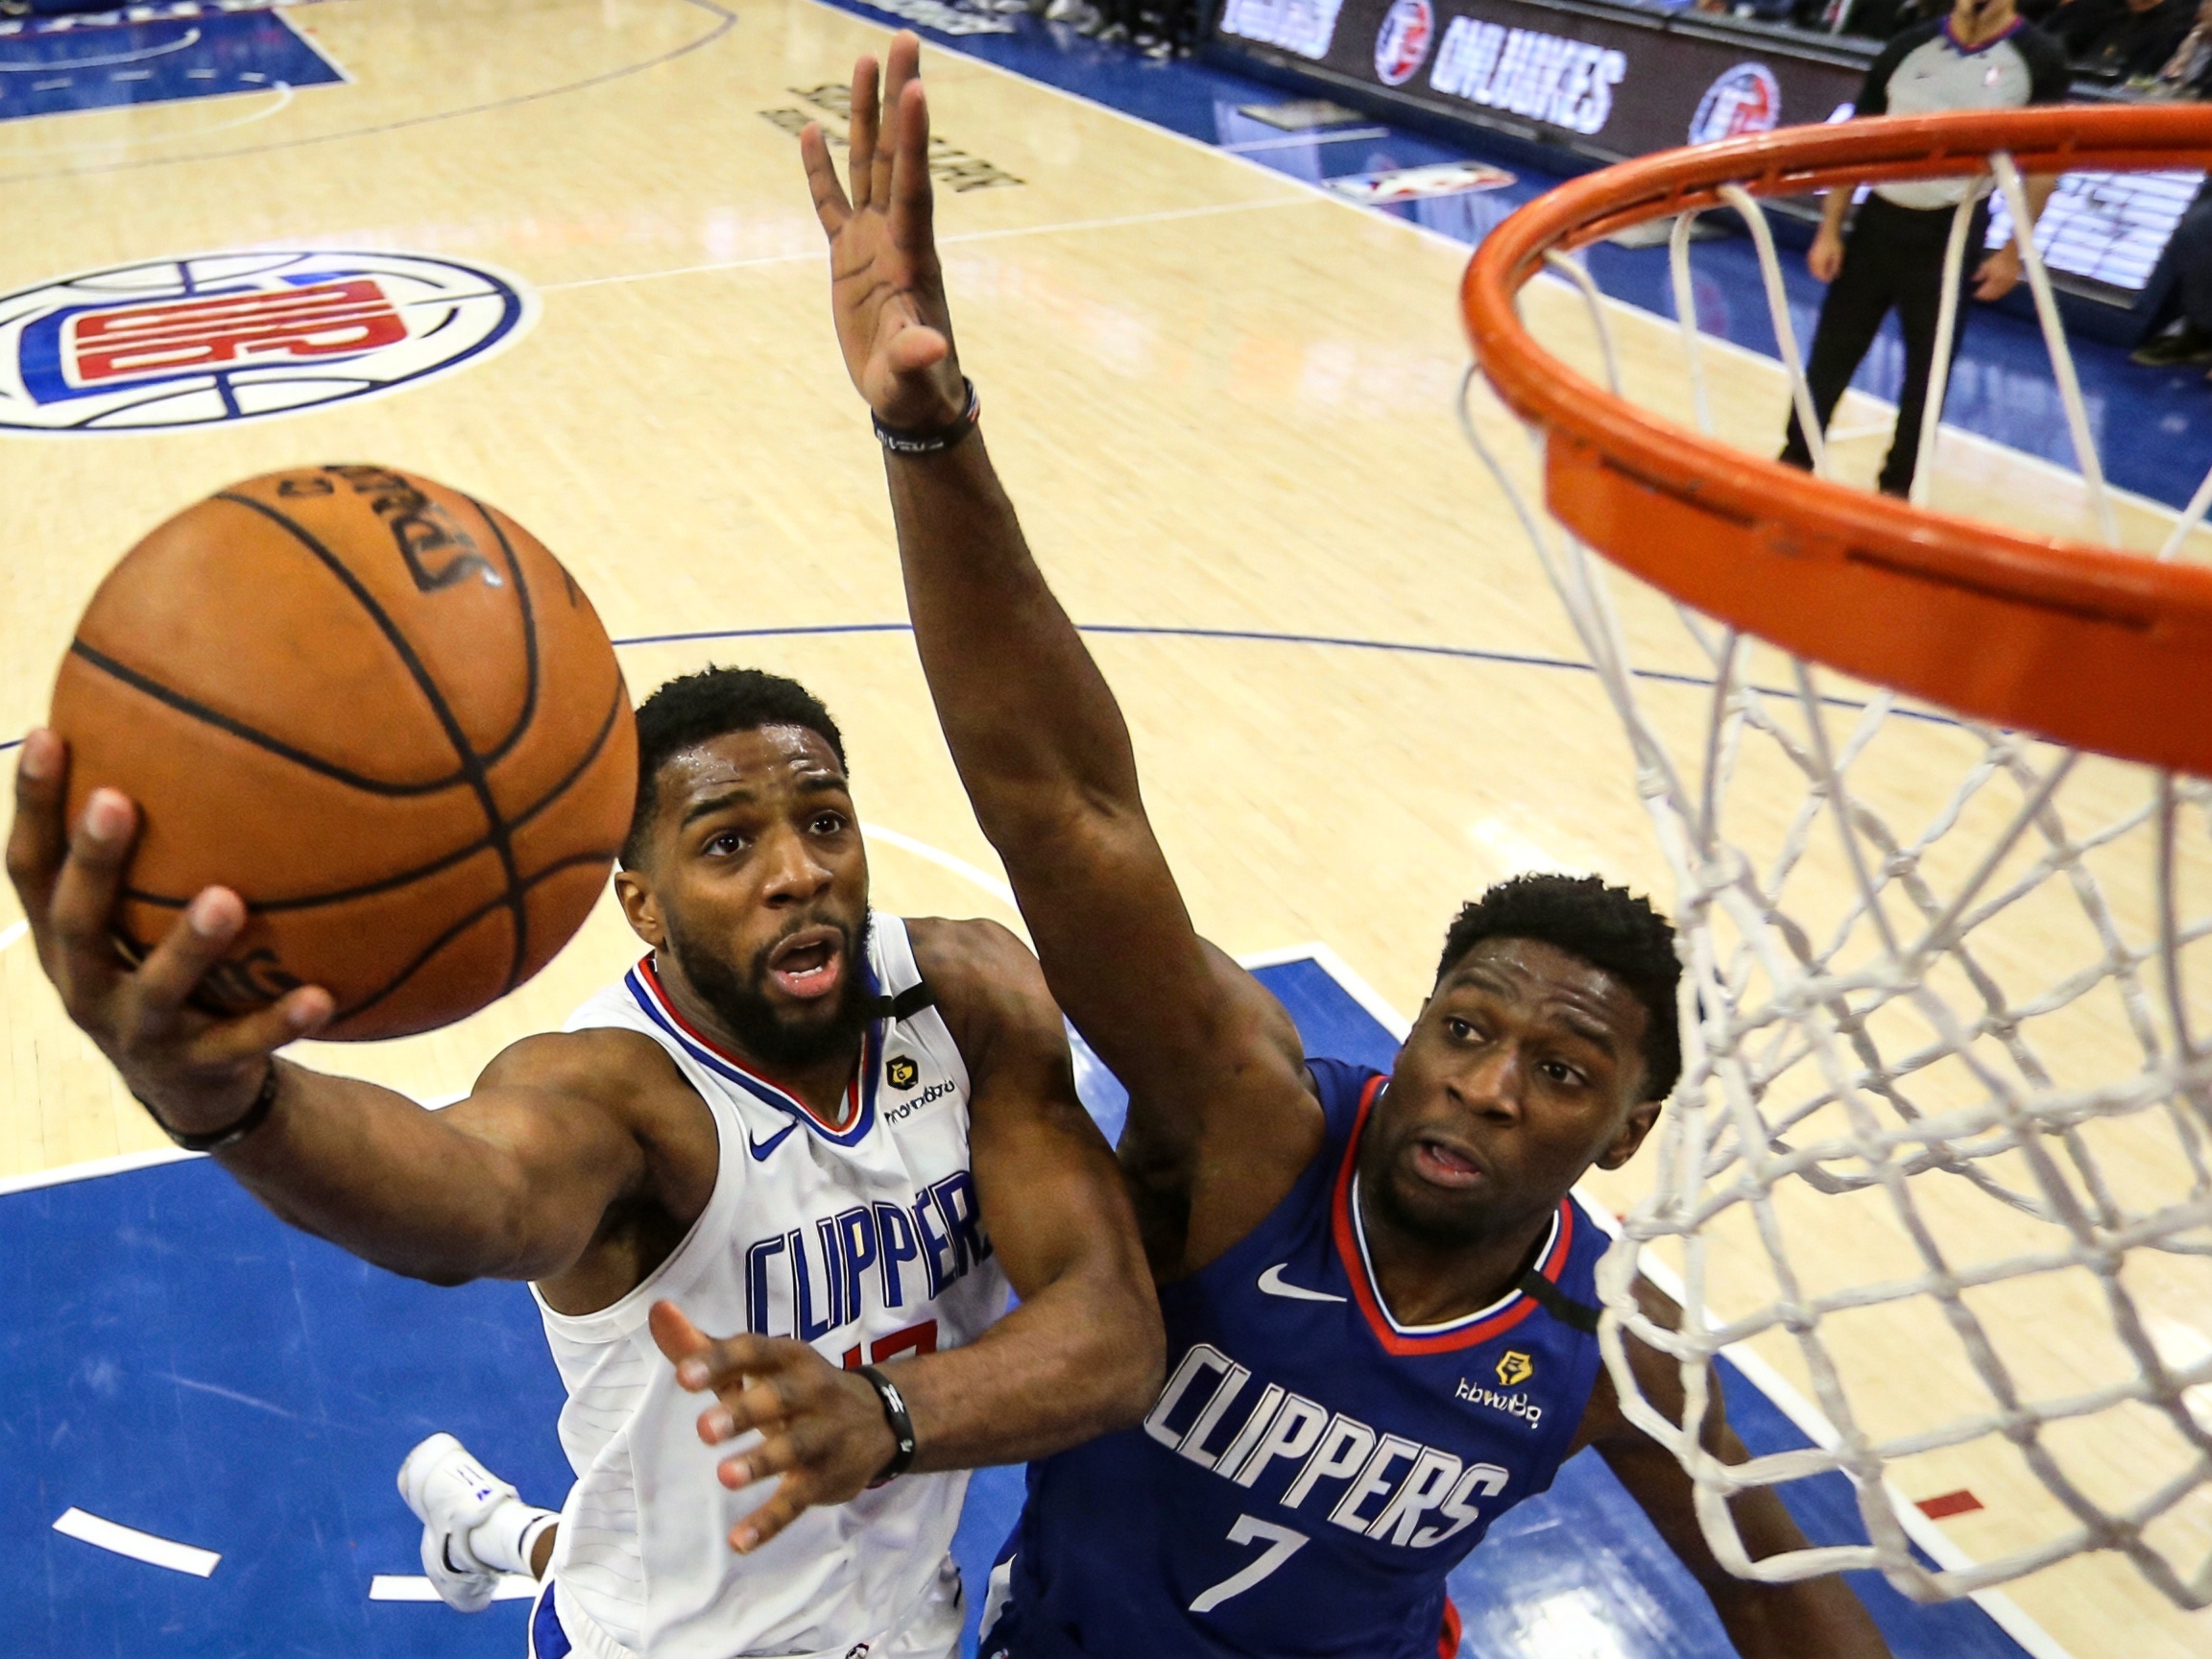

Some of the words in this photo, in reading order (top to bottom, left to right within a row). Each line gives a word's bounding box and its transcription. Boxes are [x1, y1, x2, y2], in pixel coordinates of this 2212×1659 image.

[746, 1169, 993, 1343] CLIPPER
[1143, 1343, 1508, 1548] CLIPPERS
[1189, 1514, 1310, 1612] 7
